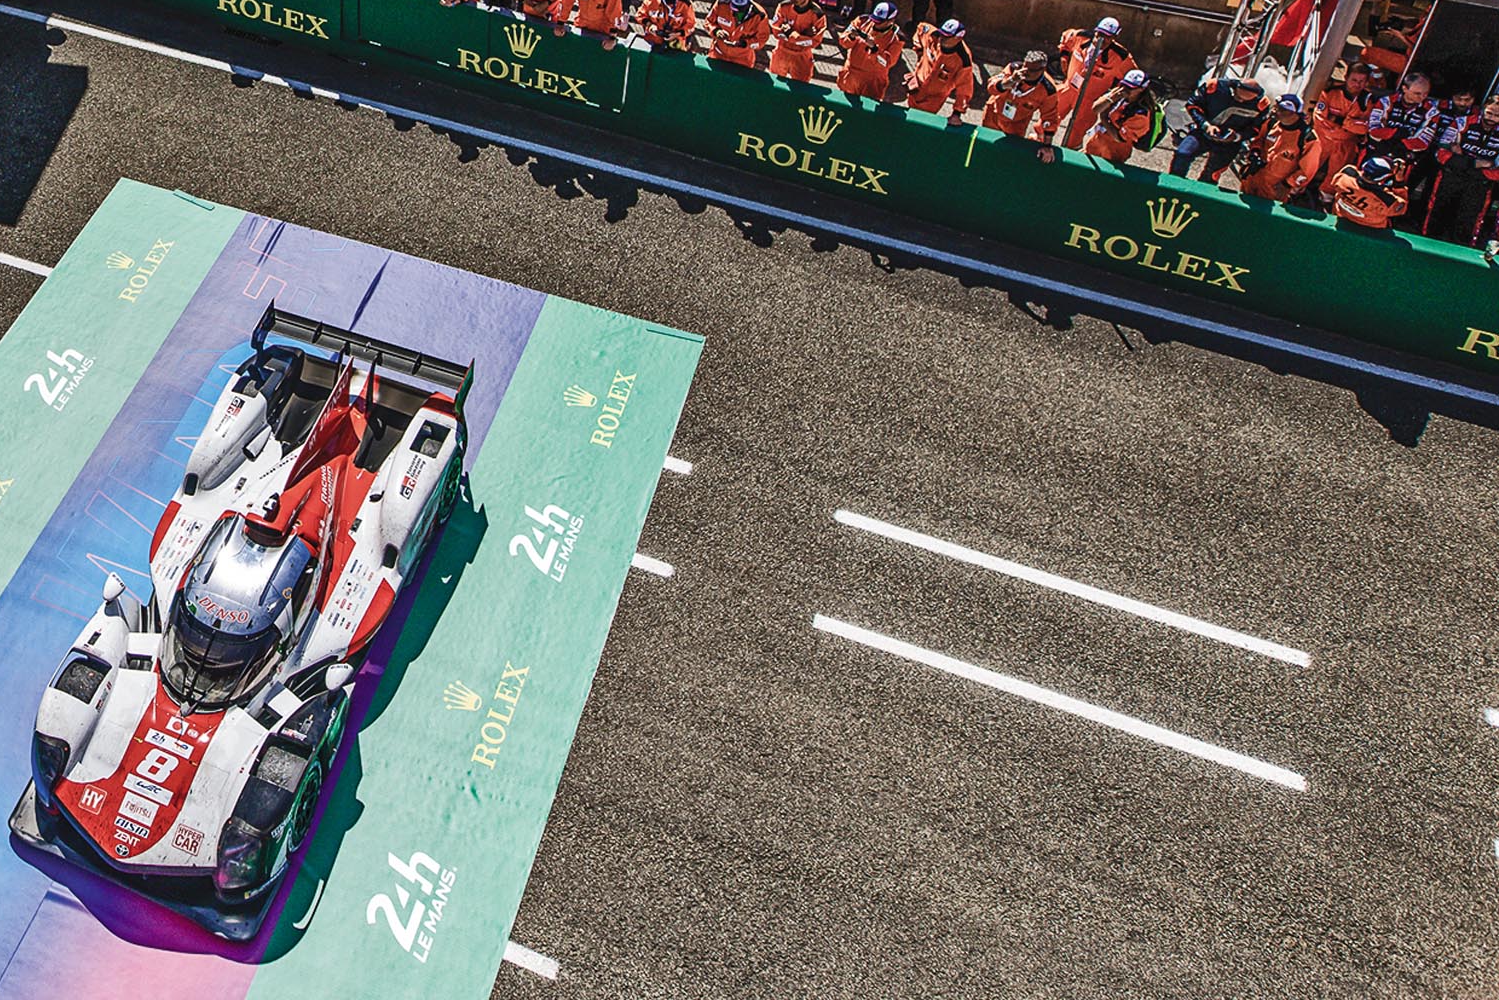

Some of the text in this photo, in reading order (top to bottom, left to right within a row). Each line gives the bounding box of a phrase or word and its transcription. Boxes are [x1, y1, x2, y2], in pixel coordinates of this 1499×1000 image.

[458, 47, 587, 101] ROLEX
[736, 131, 889, 195] ROLEX
[119, 238, 175, 303] ROLEX
[1065, 221, 1250, 293] ROLEX
[23, 348, 84, 406] 24h
[53, 358, 95, 411] LE MANS
[590, 370, 638, 449] ROLEX
[509, 504, 570, 575] 24h
[550, 516, 584, 582] LE MANS
[198, 594, 250, 625] DENSO
[471, 661, 530, 769] ROLEX
[136, 748, 179, 783] 8
[82, 788, 104, 809] HY
[124, 800, 153, 818] FUJITSU
[114, 830, 141, 847] ZENT
[174, 835, 200, 854] CAR
[178, 826, 202, 841] HYPER
[367, 851, 441, 952] 24h
[412, 868, 457, 963] LE MANS
